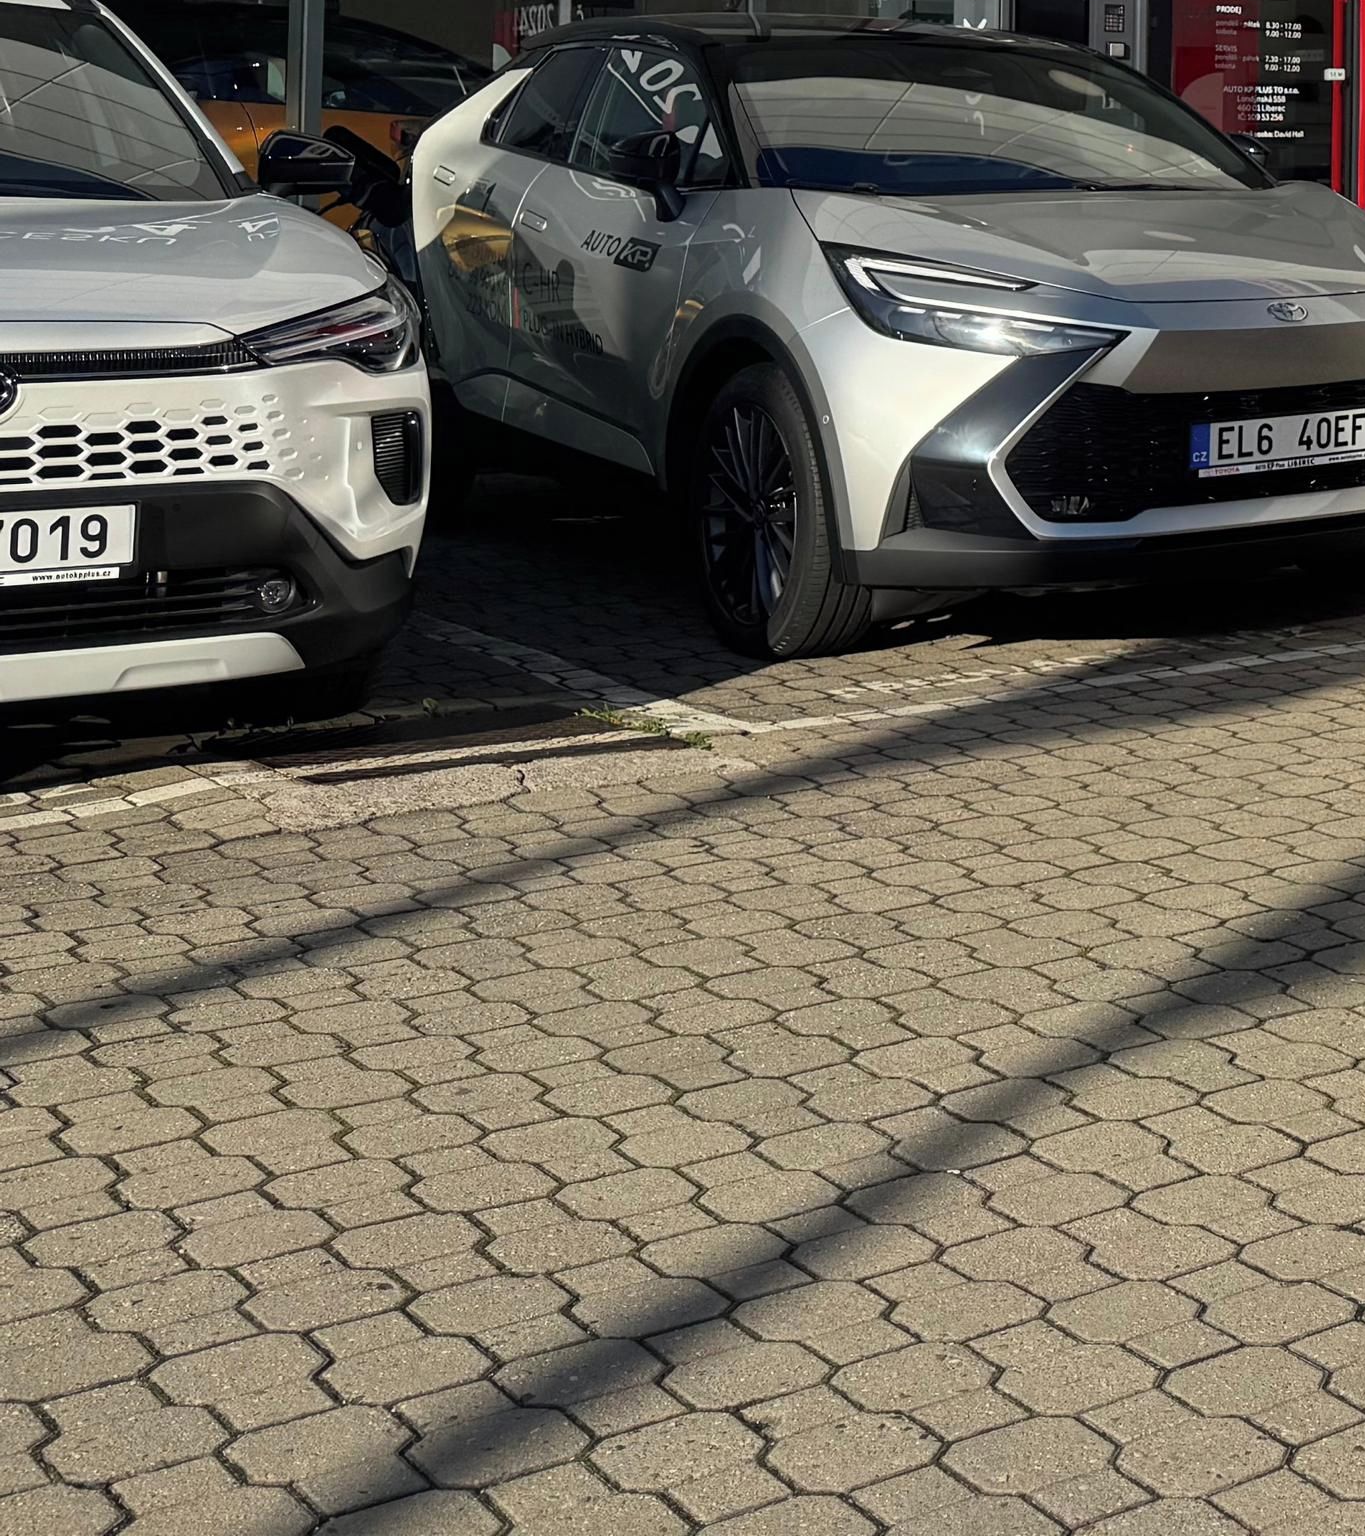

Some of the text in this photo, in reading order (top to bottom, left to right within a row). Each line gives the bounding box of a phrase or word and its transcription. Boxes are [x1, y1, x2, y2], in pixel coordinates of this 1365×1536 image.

[581, 230, 623, 258] AUTO
[1192, 451, 1208, 463] CZ
[1217, 422, 1273, 461] EL6
[0, 514, 108, 564] 019
